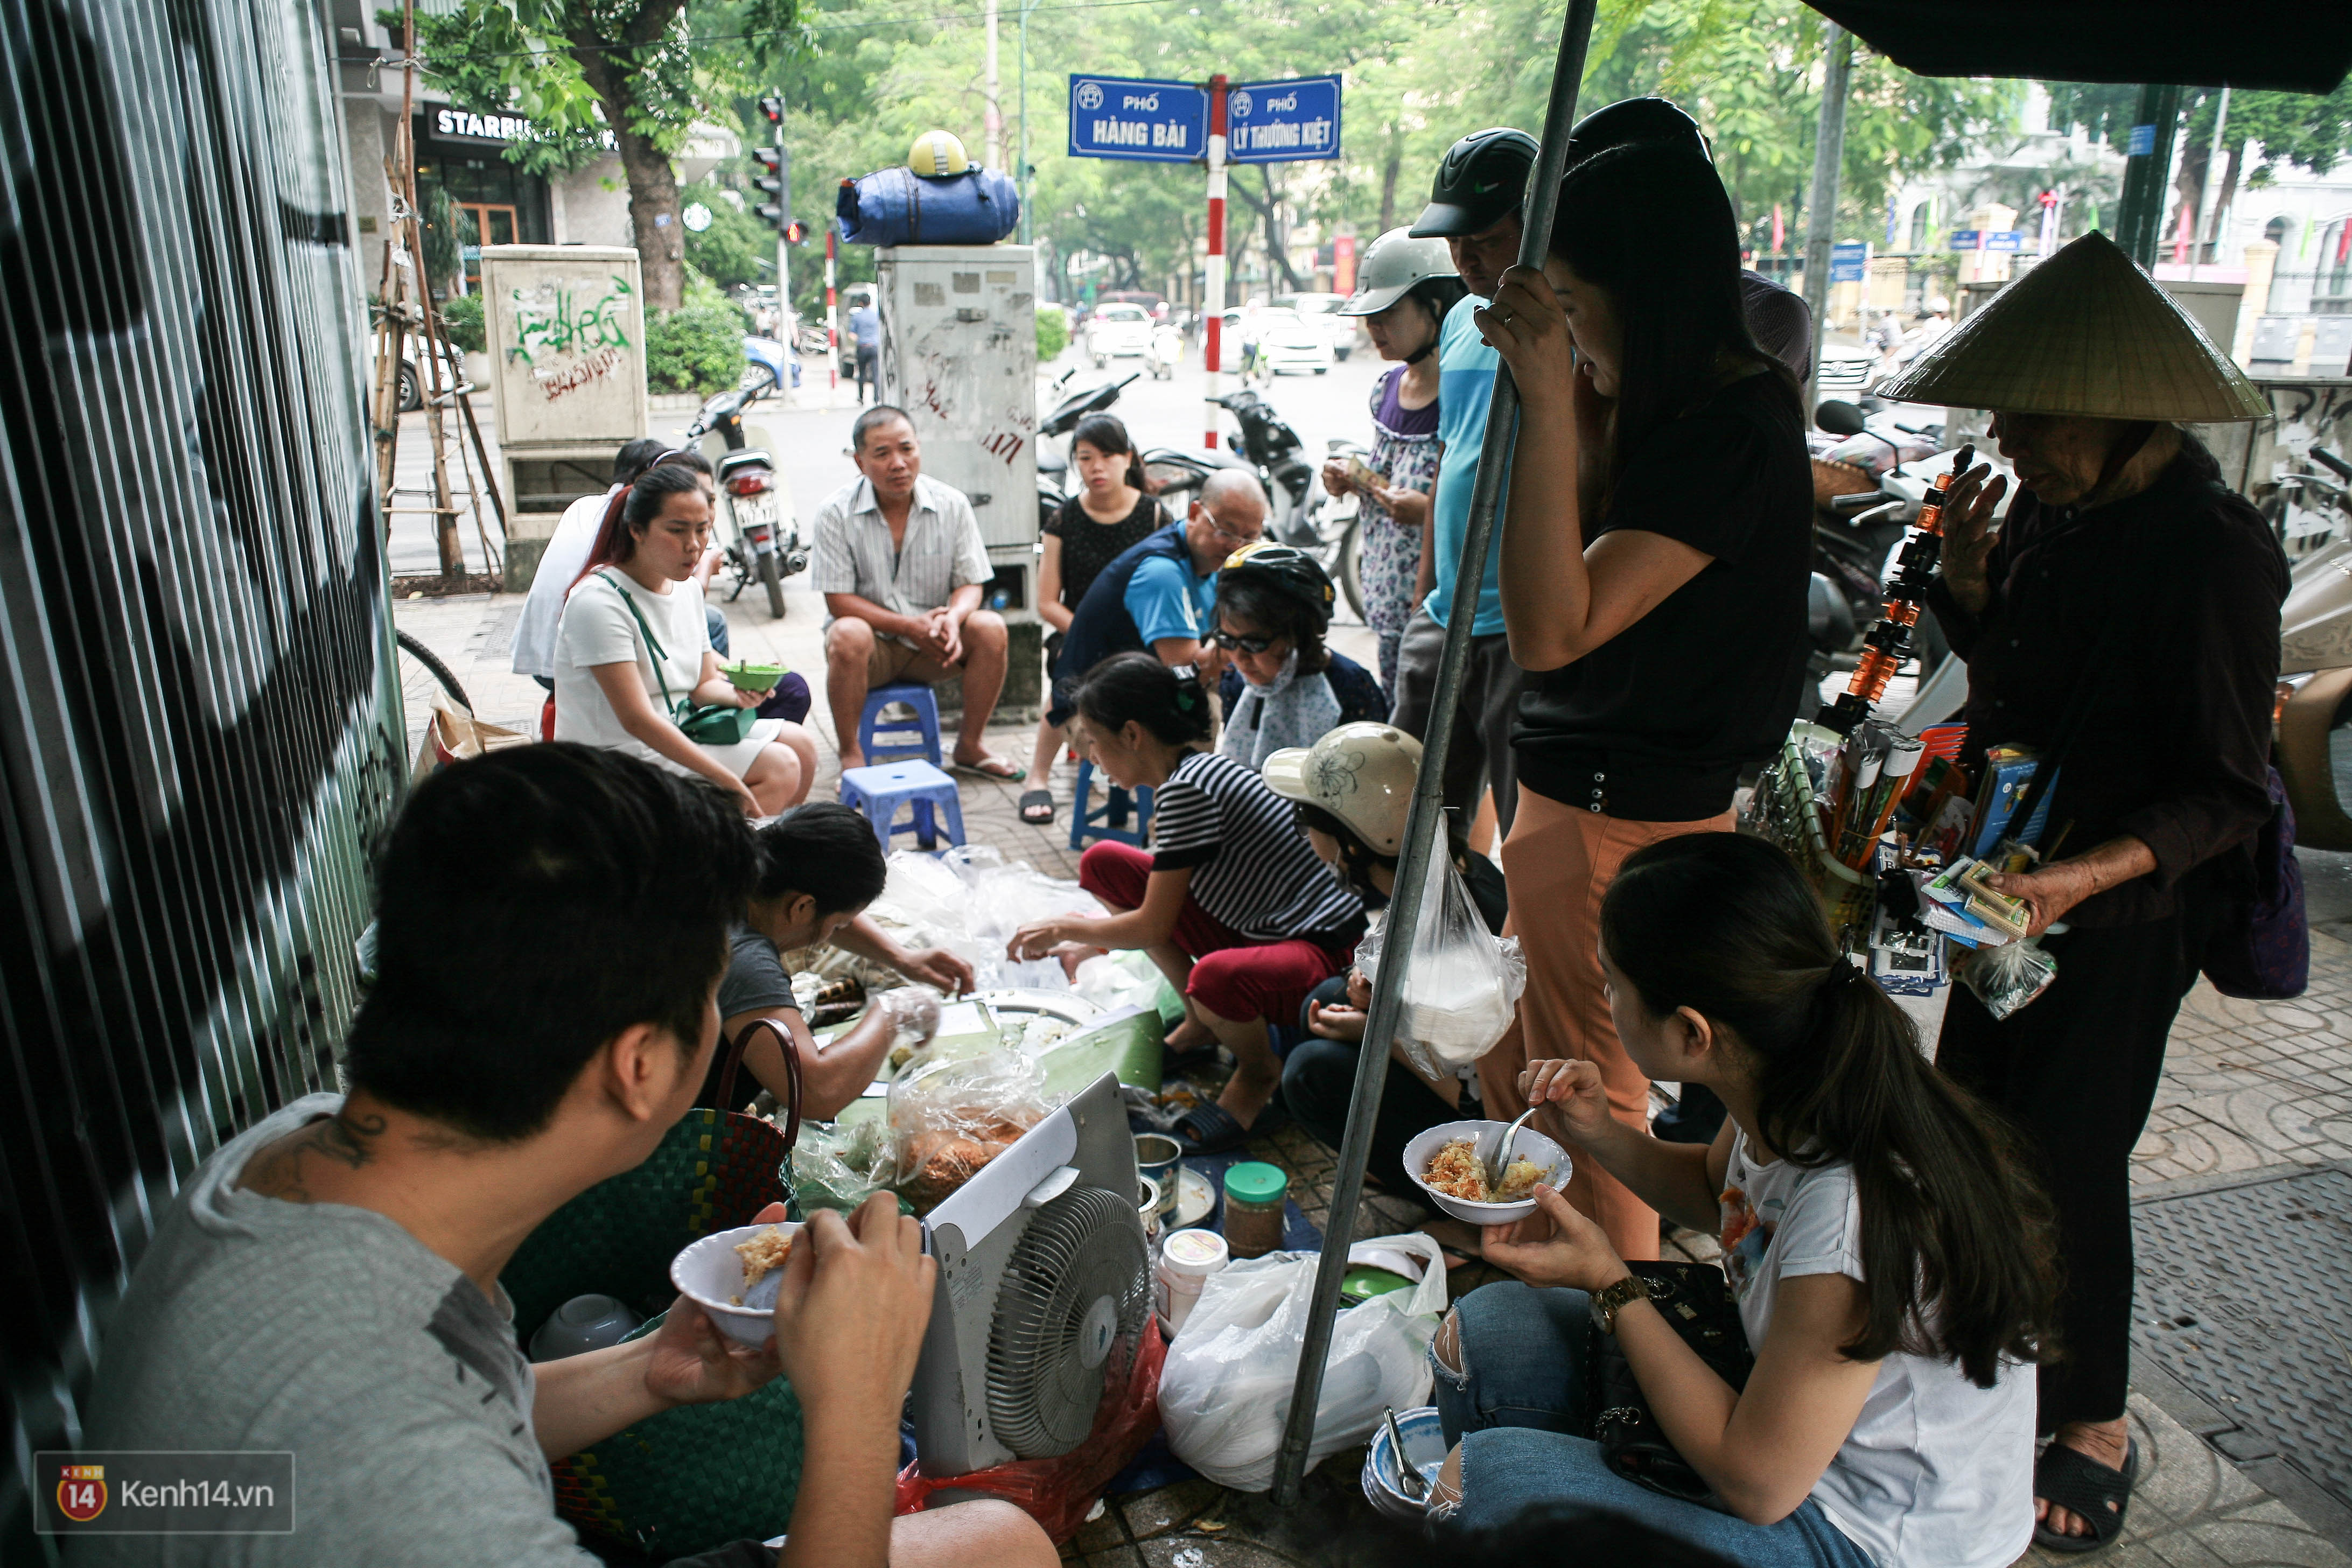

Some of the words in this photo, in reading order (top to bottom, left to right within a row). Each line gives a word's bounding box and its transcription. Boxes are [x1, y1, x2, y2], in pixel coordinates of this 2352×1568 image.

[1123, 92, 1160, 111] PHỐ
[1266, 90, 1298, 112] PHỐ
[437, 109, 557, 143] STARBU
[1093, 115, 1149, 146] HÀNG
[1152, 118, 1187, 149] BÀI
[1233, 122, 1250, 150] LÝ
[1301, 116, 1332, 150] KIỆT
